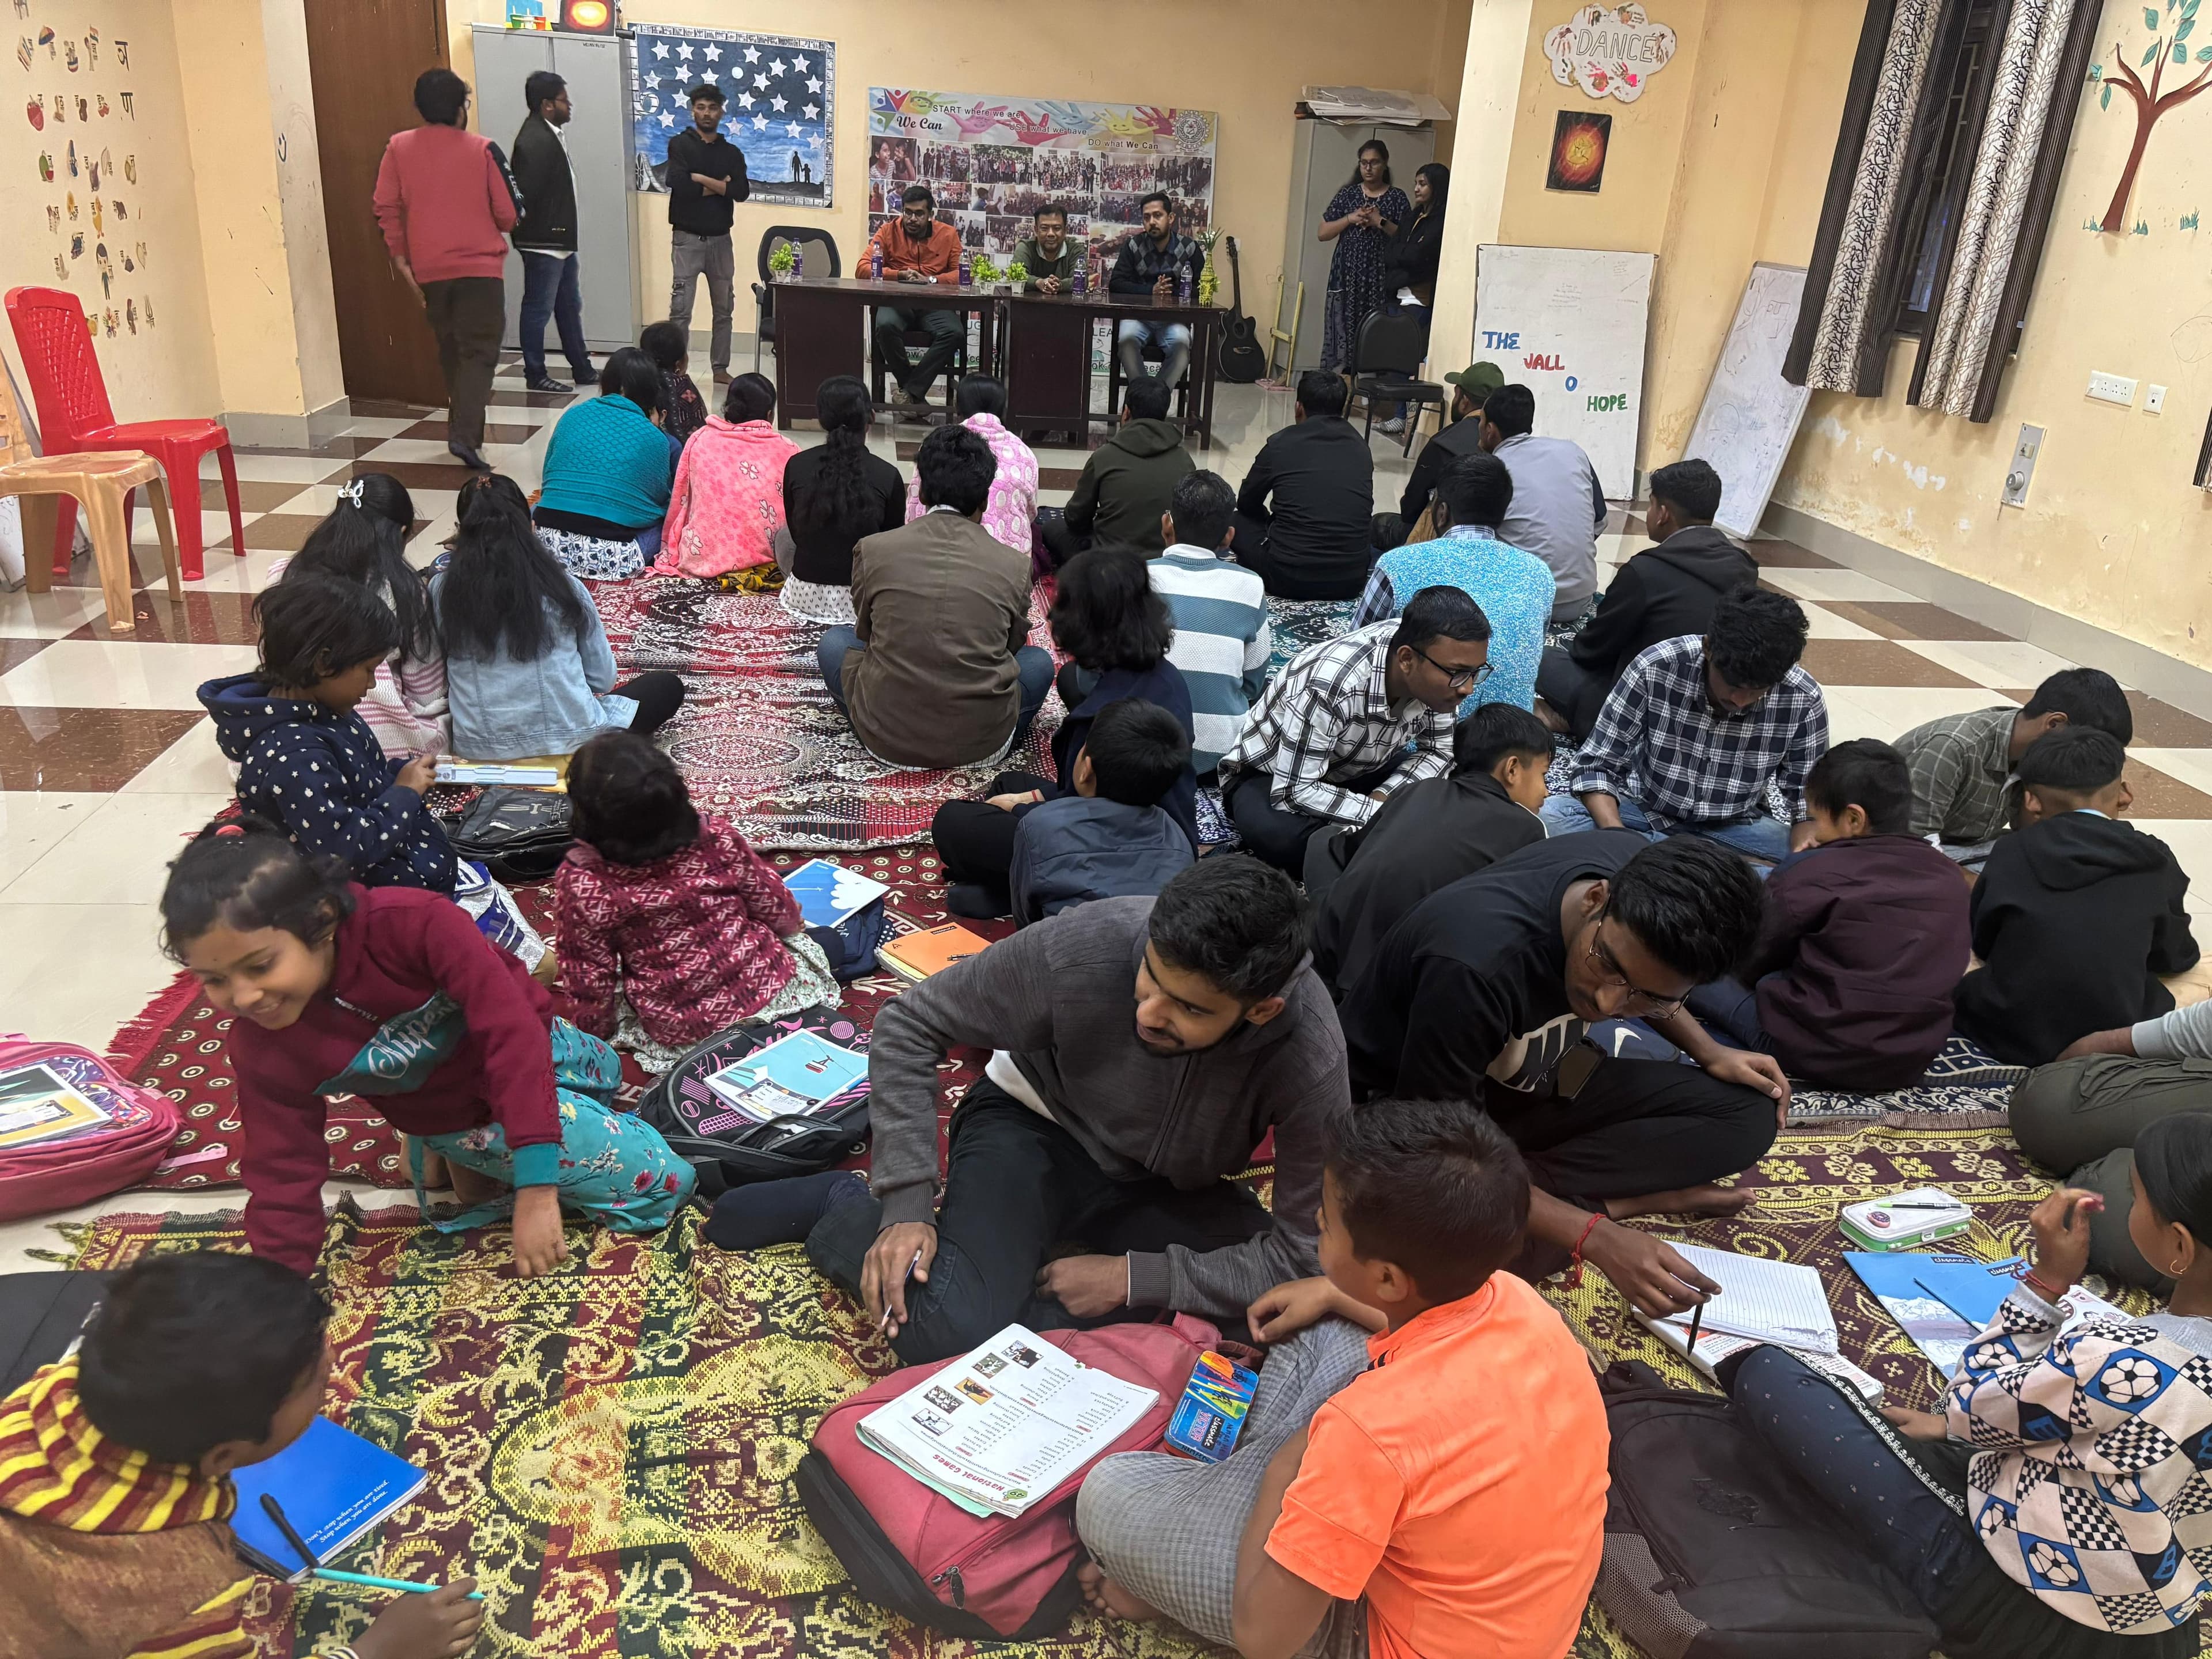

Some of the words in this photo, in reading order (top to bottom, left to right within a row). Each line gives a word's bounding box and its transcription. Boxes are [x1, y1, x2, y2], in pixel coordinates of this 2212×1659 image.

[1576, 28, 1657, 63] DANCE
[933, 104, 961, 114] START
[964, 108, 990, 116] where
[896, 116, 916, 128] We
[919, 118, 943, 130] Can
[1009, 124, 1028, 132] USE
[1030, 126, 1050, 134] what
[1088, 138, 1101, 147] DO
[1104, 139, 1123, 148] what
[1126, 141, 1139, 149] We
[1142, 141, 1159, 150] Can
[1482, 331, 1521, 350] THE
[1586, 393, 1628, 412] HOPE
[1190, 1411, 1211, 1442] VICTOR
[1204, 1416, 1222, 1447] classmate
[932, 1453, 961, 1474] Games
[960, 1471, 1005, 1492] National
[1009, 1490, 1025, 1498] 49
[336, 1508, 353, 1521] when
[353, 1499, 365, 1510] you
[365, 1491, 374, 1501] are
[320, 1529, 335, 1543] Stop
[335, 1517, 351, 1531] when
[351, 1509, 363, 1521] you
[363, 1501, 372, 1511] are
[373, 1490, 388, 1502] done.
